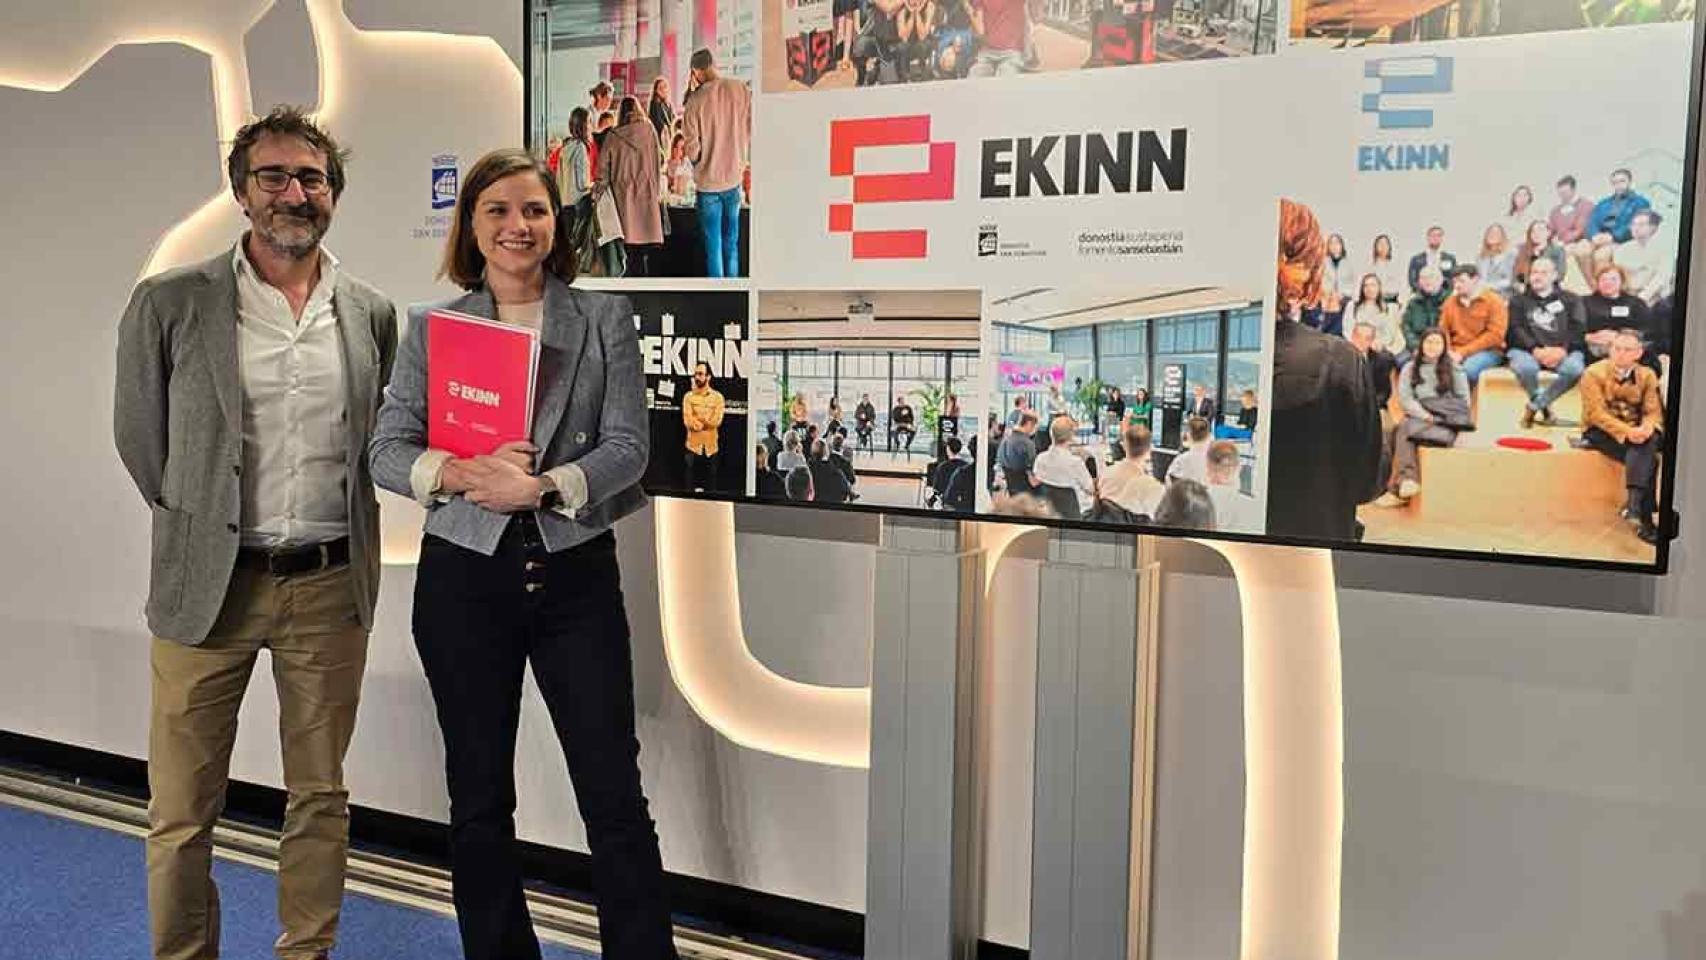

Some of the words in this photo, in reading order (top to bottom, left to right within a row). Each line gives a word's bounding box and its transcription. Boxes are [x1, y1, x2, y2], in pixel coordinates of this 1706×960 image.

[979, 128, 1187, 199] EKINN
[1358, 144, 1450, 171] EKINN
[643, 335, 749, 379] EKINN
